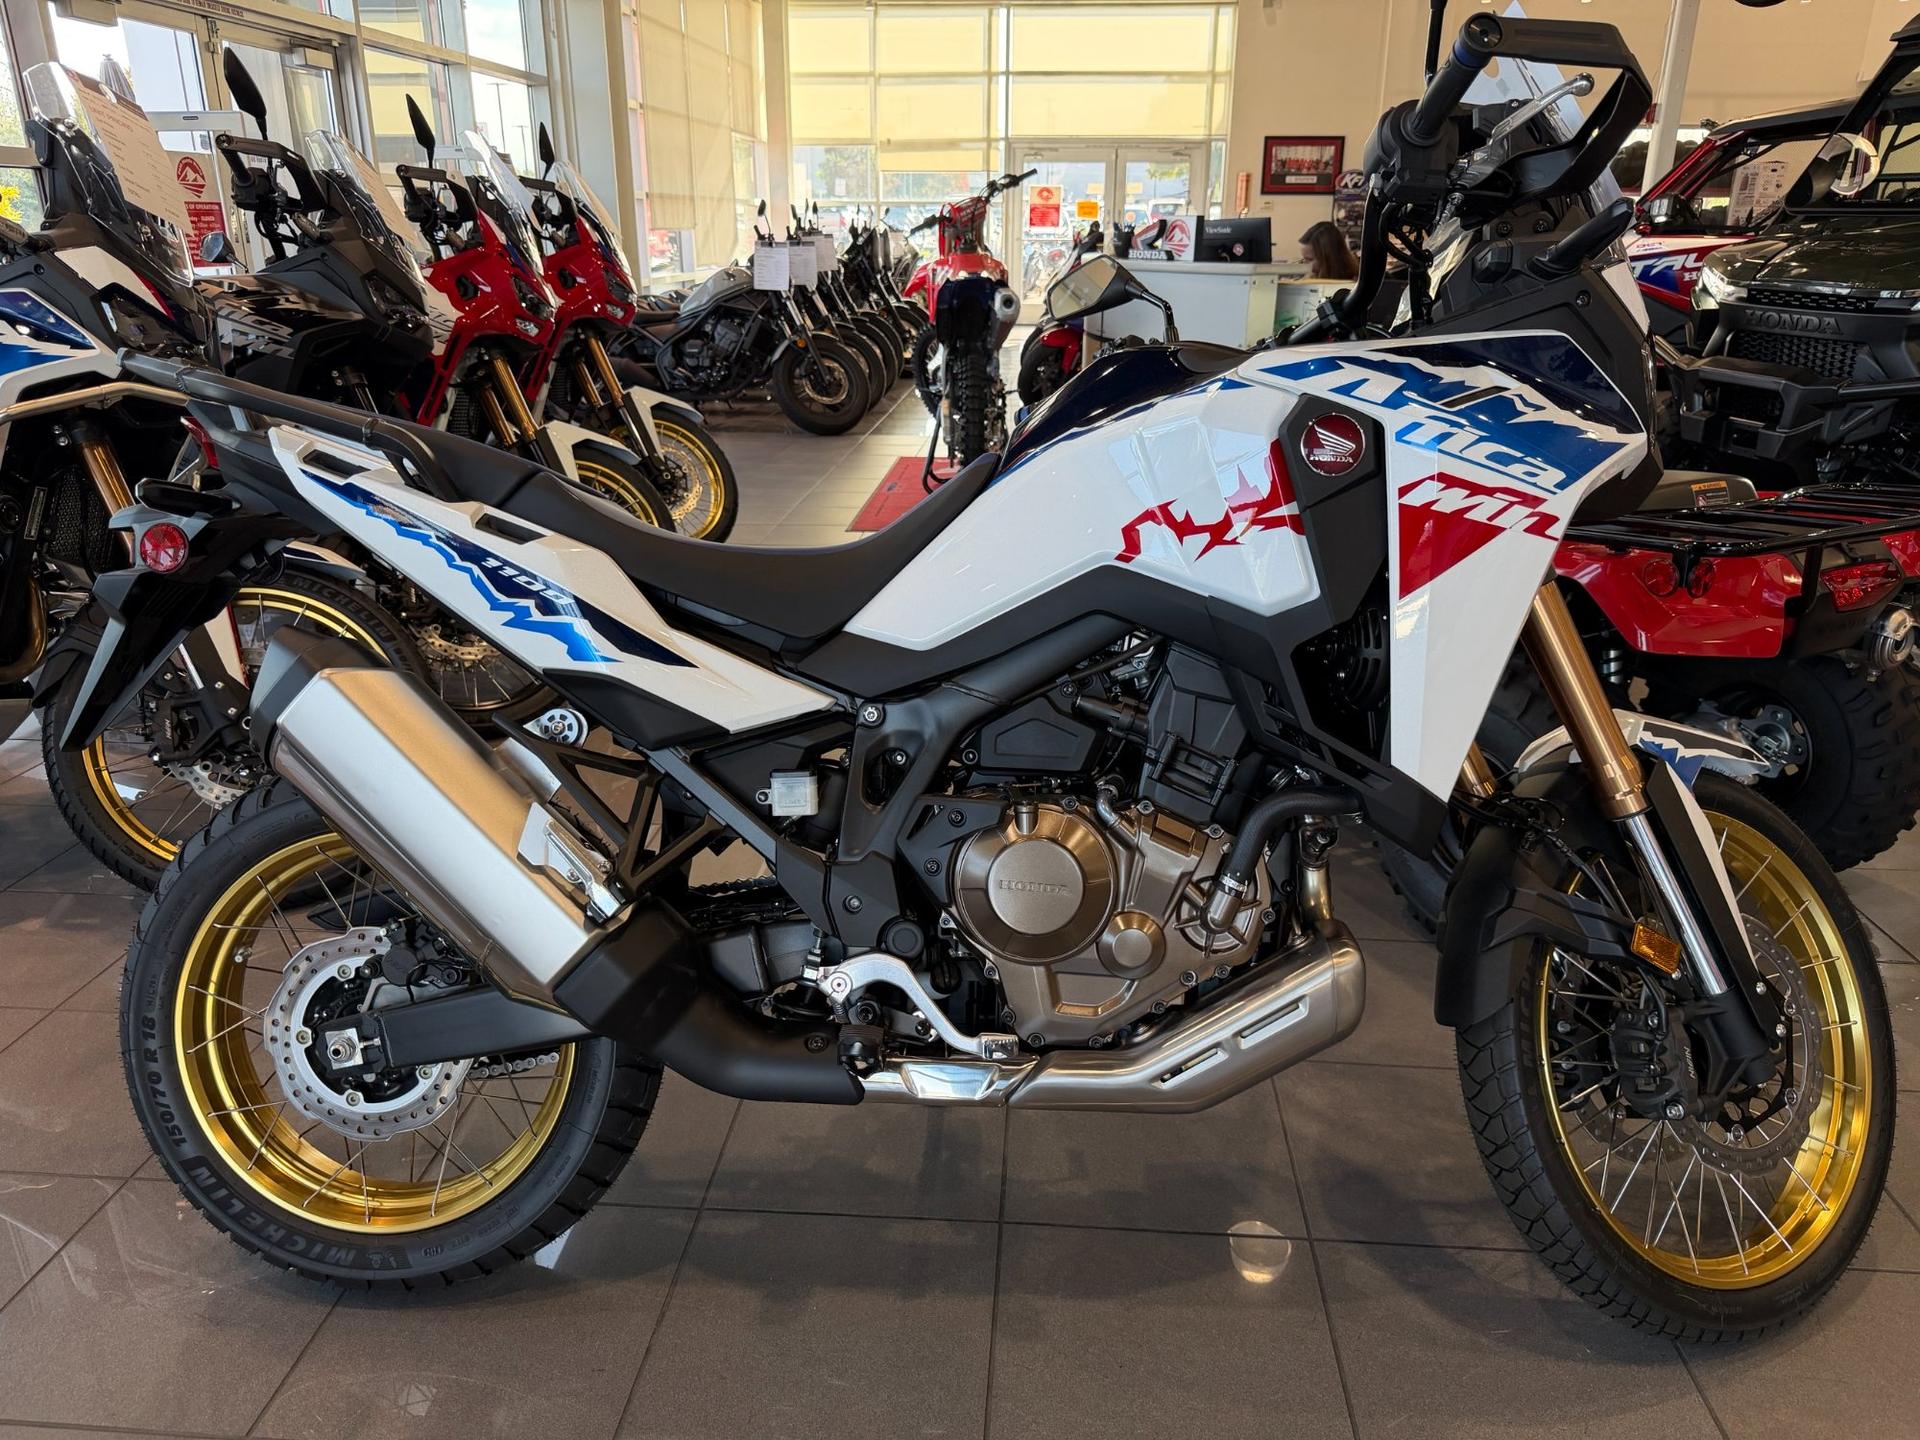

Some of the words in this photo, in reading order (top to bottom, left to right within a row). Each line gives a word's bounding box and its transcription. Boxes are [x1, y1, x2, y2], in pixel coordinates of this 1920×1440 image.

[1128, 249, 1168, 260] HONDA
[1743, 309, 1844, 335] HONDA
[1309, 453, 1354, 464] HONDA
[481, 556, 574, 605] 1100
[293, 576, 392, 642] MICHELIN
[999, 879, 1073, 897] HONDA
[142, 1015, 156, 1041] 18
[144, 1049, 159, 1063] R
[147, 1070, 188, 1148] 150/70
[190, 1166, 357, 1267] MICHELIN
